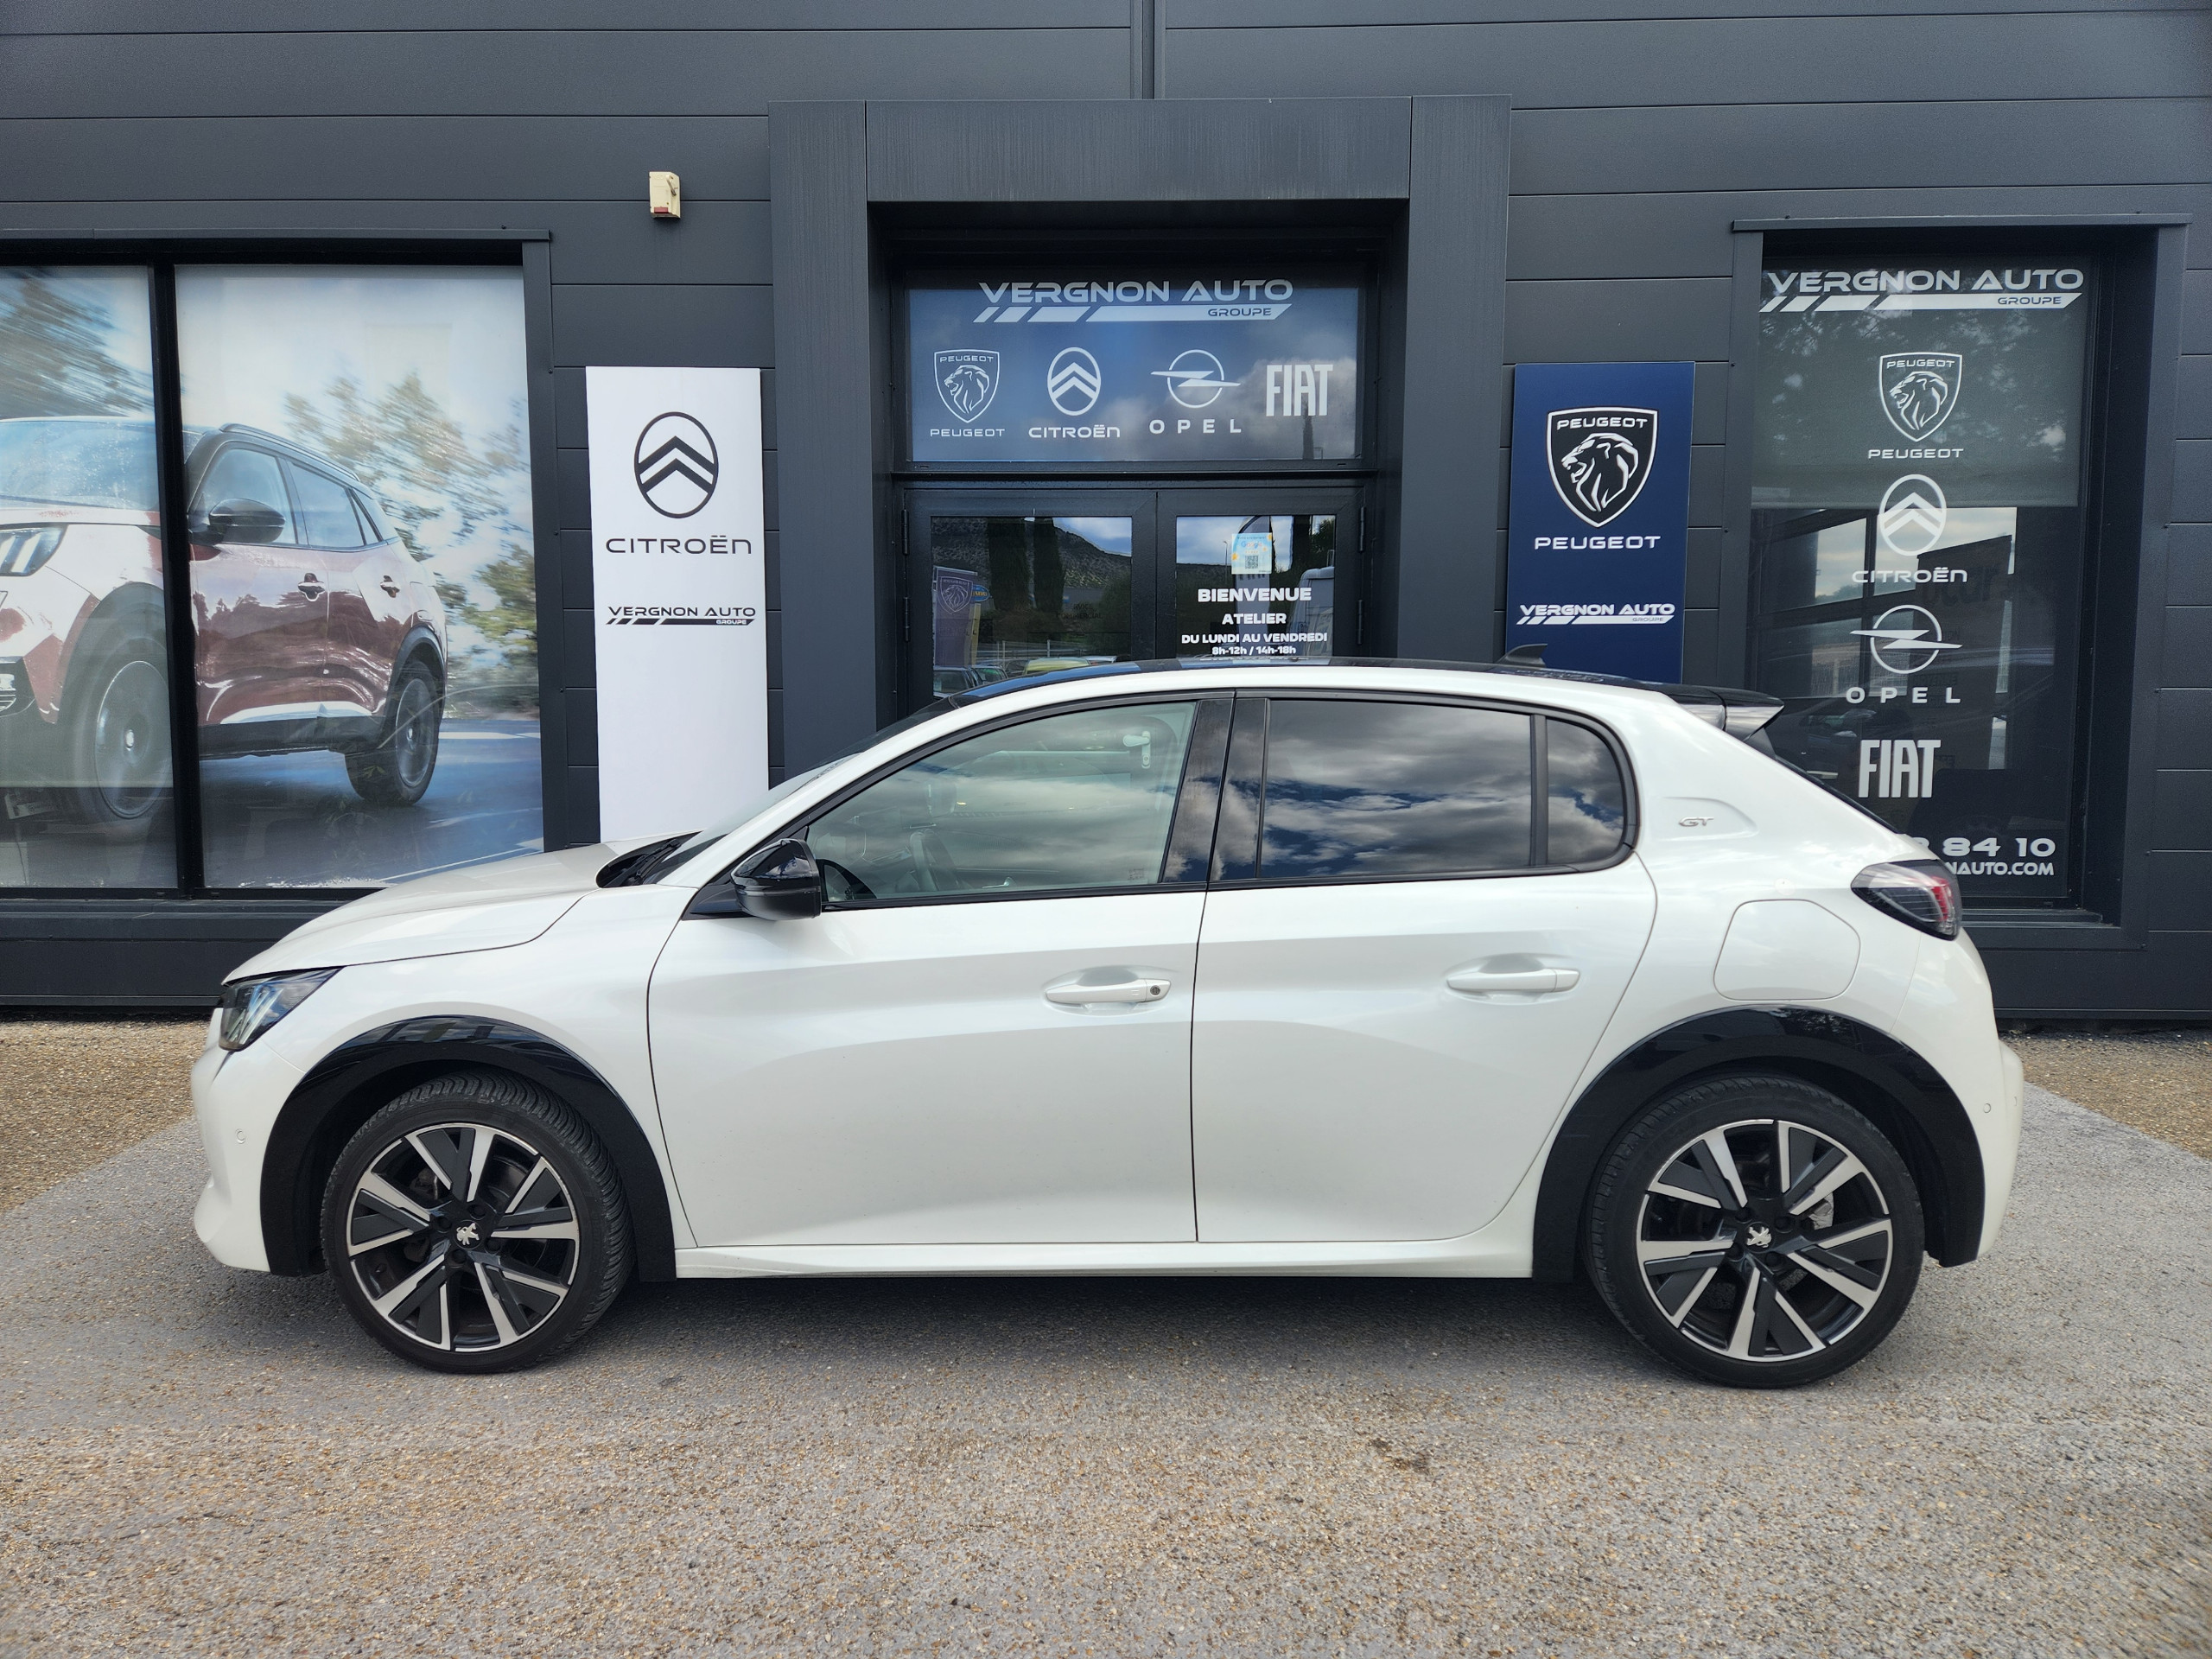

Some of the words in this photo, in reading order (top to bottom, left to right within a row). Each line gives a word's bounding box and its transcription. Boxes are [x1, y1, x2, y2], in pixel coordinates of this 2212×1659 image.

[1767, 270, 1960, 294] VERGNON
[1971, 268, 2084, 291] AUTO
[978, 280, 1170, 304] VERGNON
[1180, 278, 1294, 302] AUTO
[1997, 296, 2063, 306] GROUPE
[1207, 308, 1273, 318] GROUPE
[939, 354, 995, 363] PEUGEOT
[1885, 359, 1955, 369] PEUGEOT
[1265, 364, 1334, 417] FIAT
[1148, 418, 1243, 435] OPEL
[1556, 416, 1649, 430] PEUGEOT
[930, 428, 1006, 437] PEUGEOT
[1027, 424, 1121, 439] CITROËN
[1867, 448, 1965, 460] PEUGEOT
[605, 534, 753, 554] CITROËN
[1534, 535, 1662, 550] PEUGEOT
[1852, 566, 1968, 583] CITROËN
[1198, 587, 1313, 602] BIENVENUE
[607, 606, 698, 617] VERGNON
[703, 606, 756, 617] AUTO
[1519, 603, 1617, 616] VERGNON
[1618, 602, 1675, 616] AUTO
[1222, 613, 1287, 625] ATELIER
[1181, 634, 1200, 644] DU
[1202, 633, 1240, 644] LUNDI
[1242, 633, 1262, 643] AU
[1264, 632, 1328, 644] VENDREDI
[1211, 646, 1248, 655] 8h-12h
[1256, 645, 1297, 655] 14h-18h
[1845, 686, 1962, 704] OPEL
[1858, 739, 1942, 798] FIAT
[1678, 817, 1714, 827] GT
[1942, 836, 2002, 857] 84
[2016, 836, 2056, 857] 10
